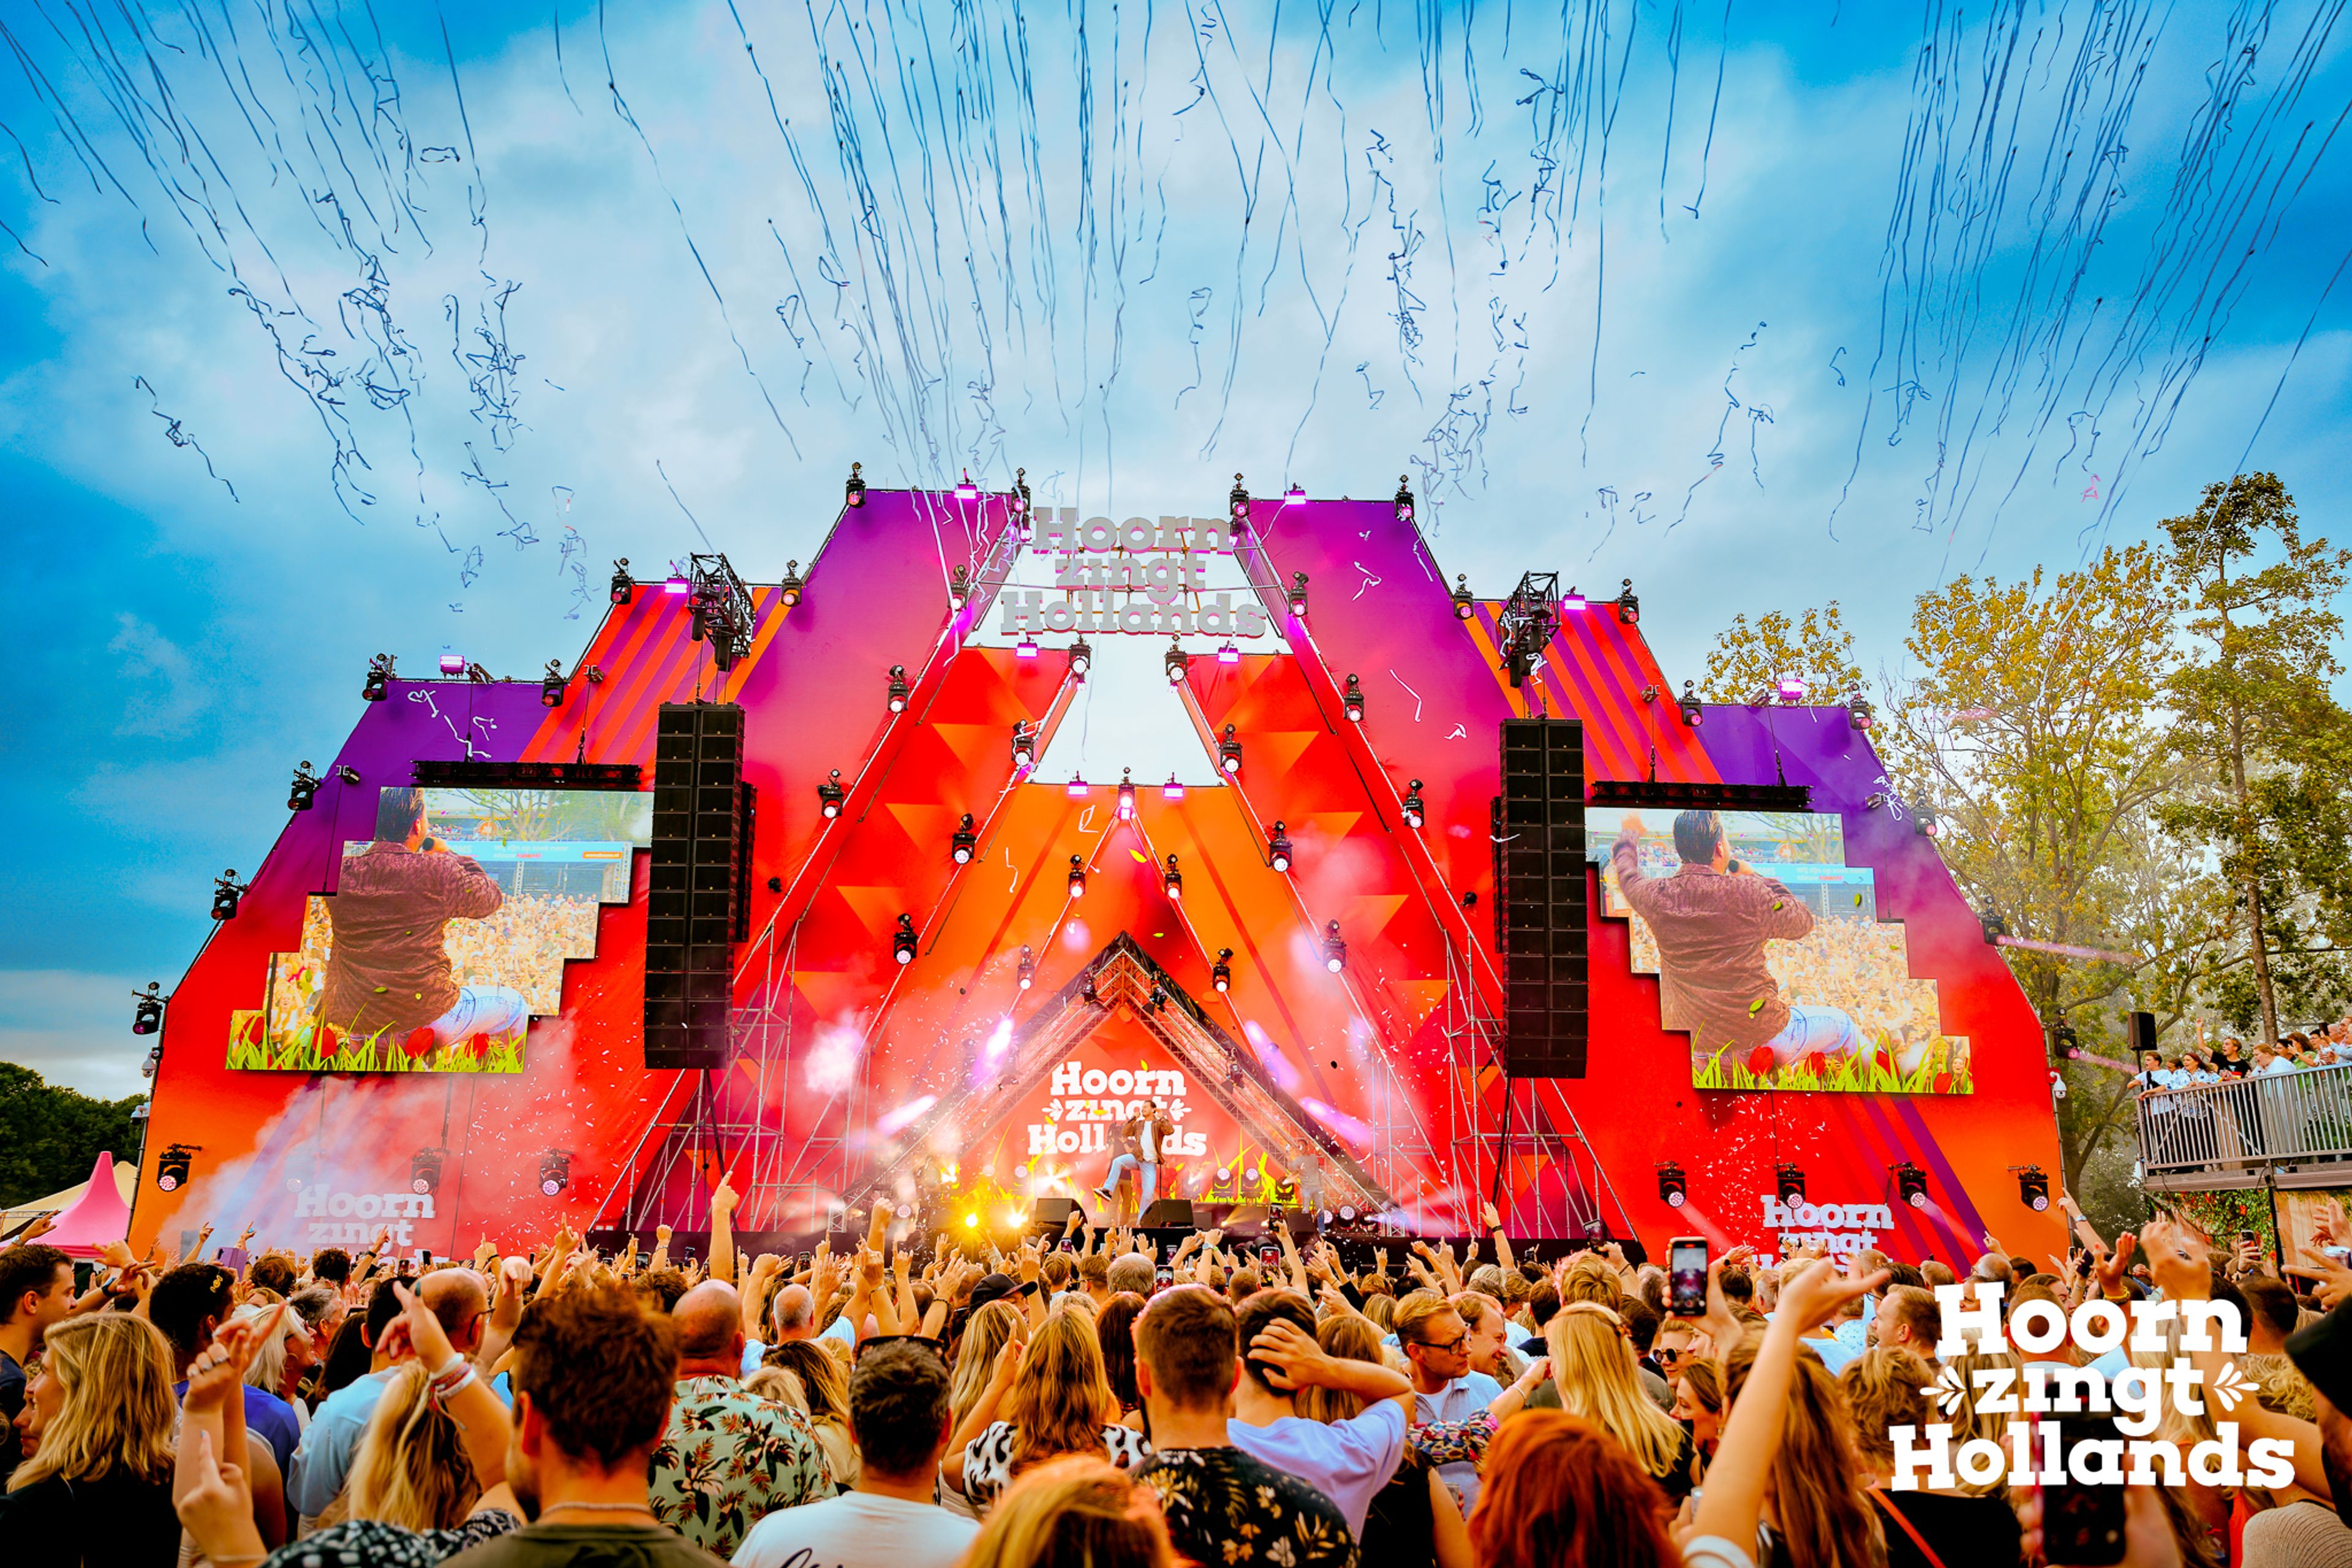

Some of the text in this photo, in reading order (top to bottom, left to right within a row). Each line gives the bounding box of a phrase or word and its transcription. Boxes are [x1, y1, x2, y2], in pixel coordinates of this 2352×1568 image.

[1033, 507, 1234, 554] Hoorn
[1055, 552, 1206, 605] zingt
[1000, 591, 1267, 638] Hollands
[1050, 1061, 1187, 1096] Hoorn
[1027, 1124, 1207, 1156] Hollds
[294, 1183, 435, 1219] Hoorn
[1760, 1194, 1894, 1230] Hoorn
[307, 1219, 413, 1254] zingt
